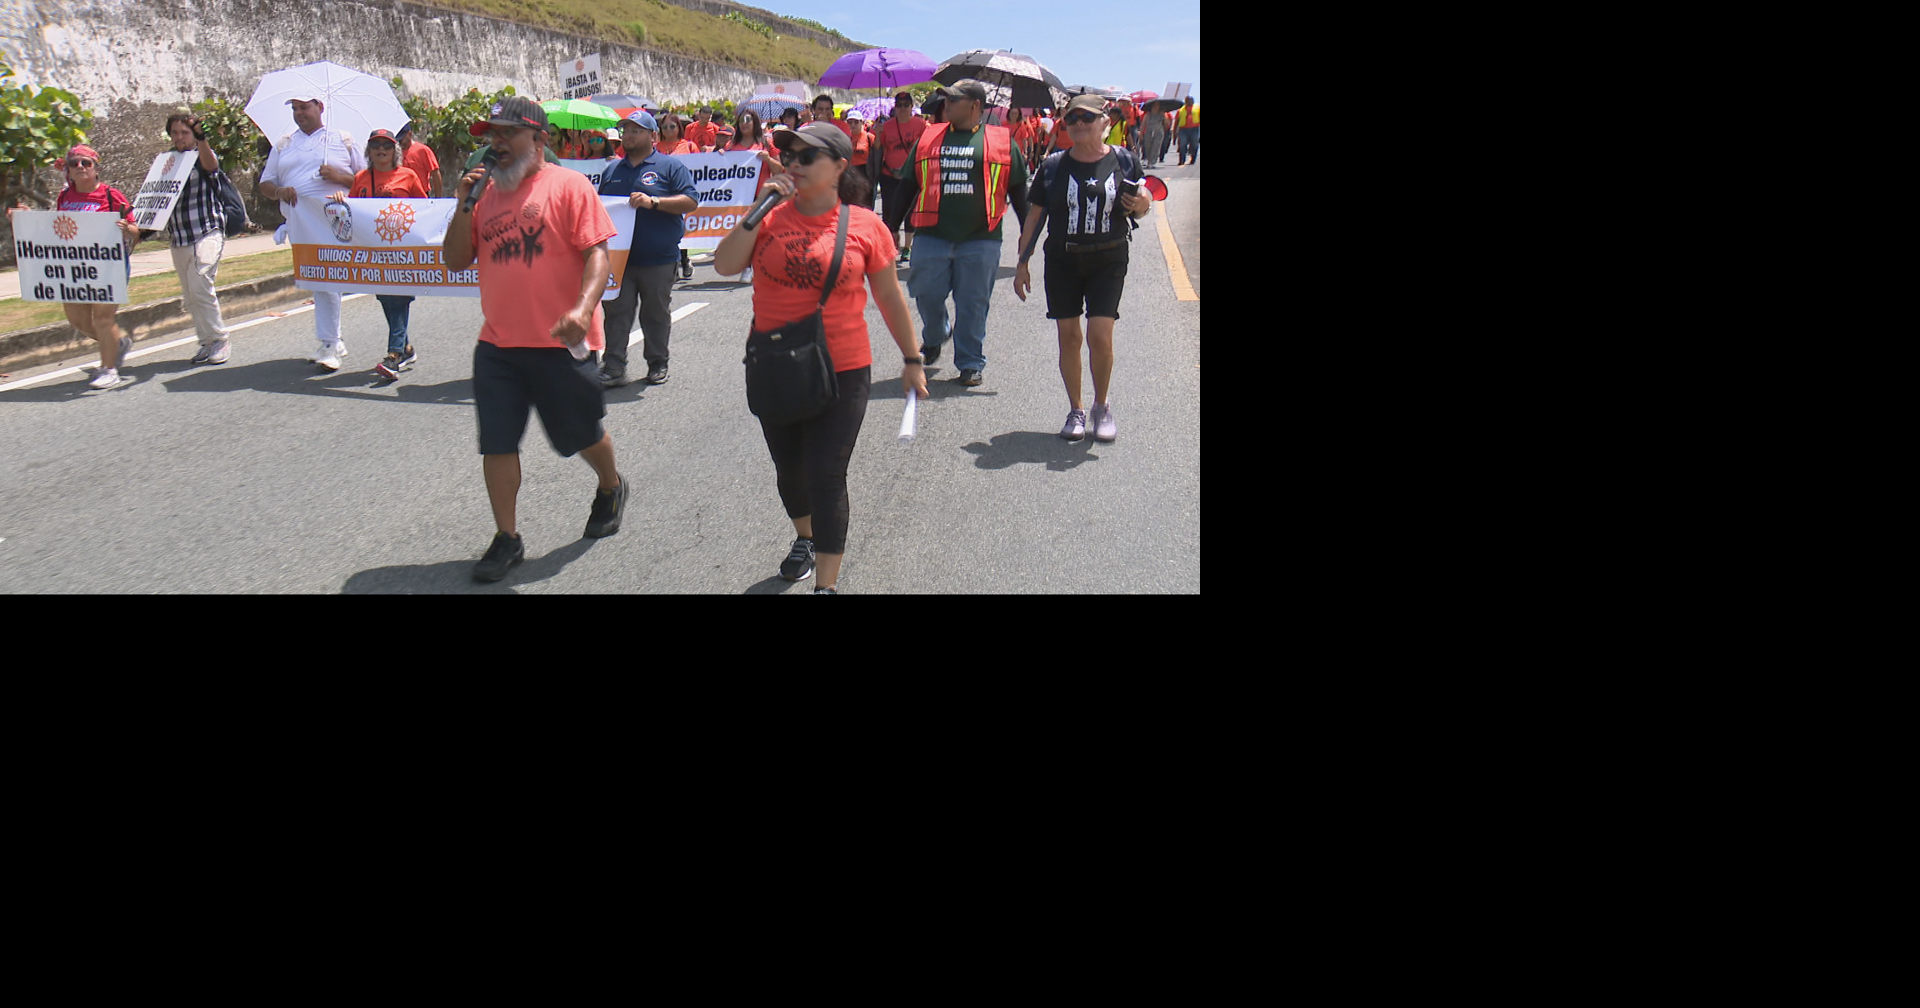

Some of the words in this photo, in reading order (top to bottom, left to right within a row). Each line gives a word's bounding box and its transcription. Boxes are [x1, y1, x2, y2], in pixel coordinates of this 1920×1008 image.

[588, 70, 598, 82] YA
[948, 172, 968, 181] una
[697, 187, 733, 202] ntes
[943, 183, 975, 195] DIGNA
[17, 240, 122, 261] ¡Hermandad
[318, 248, 352, 263] UNIDOS
[354, 250, 369, 264] EN
[370, 251, 415, 265] DEFENSA
[419, 251, 435, 265] DE
[44, 264, 65, 279] en
[71, 262, 98, 283] pie
[299, 265, 326, 280] PUERTO
[328, 266, 349, 281] RICO
[351, 267, 358, 281] Y
[361, 268, 381, 283] POR
[384, 269, 443, 284] NUESTROS
[447, 269, 480, 284] DERE
[34, 282, 55, 300] de
[60, 283, 115, 302] lucha!
